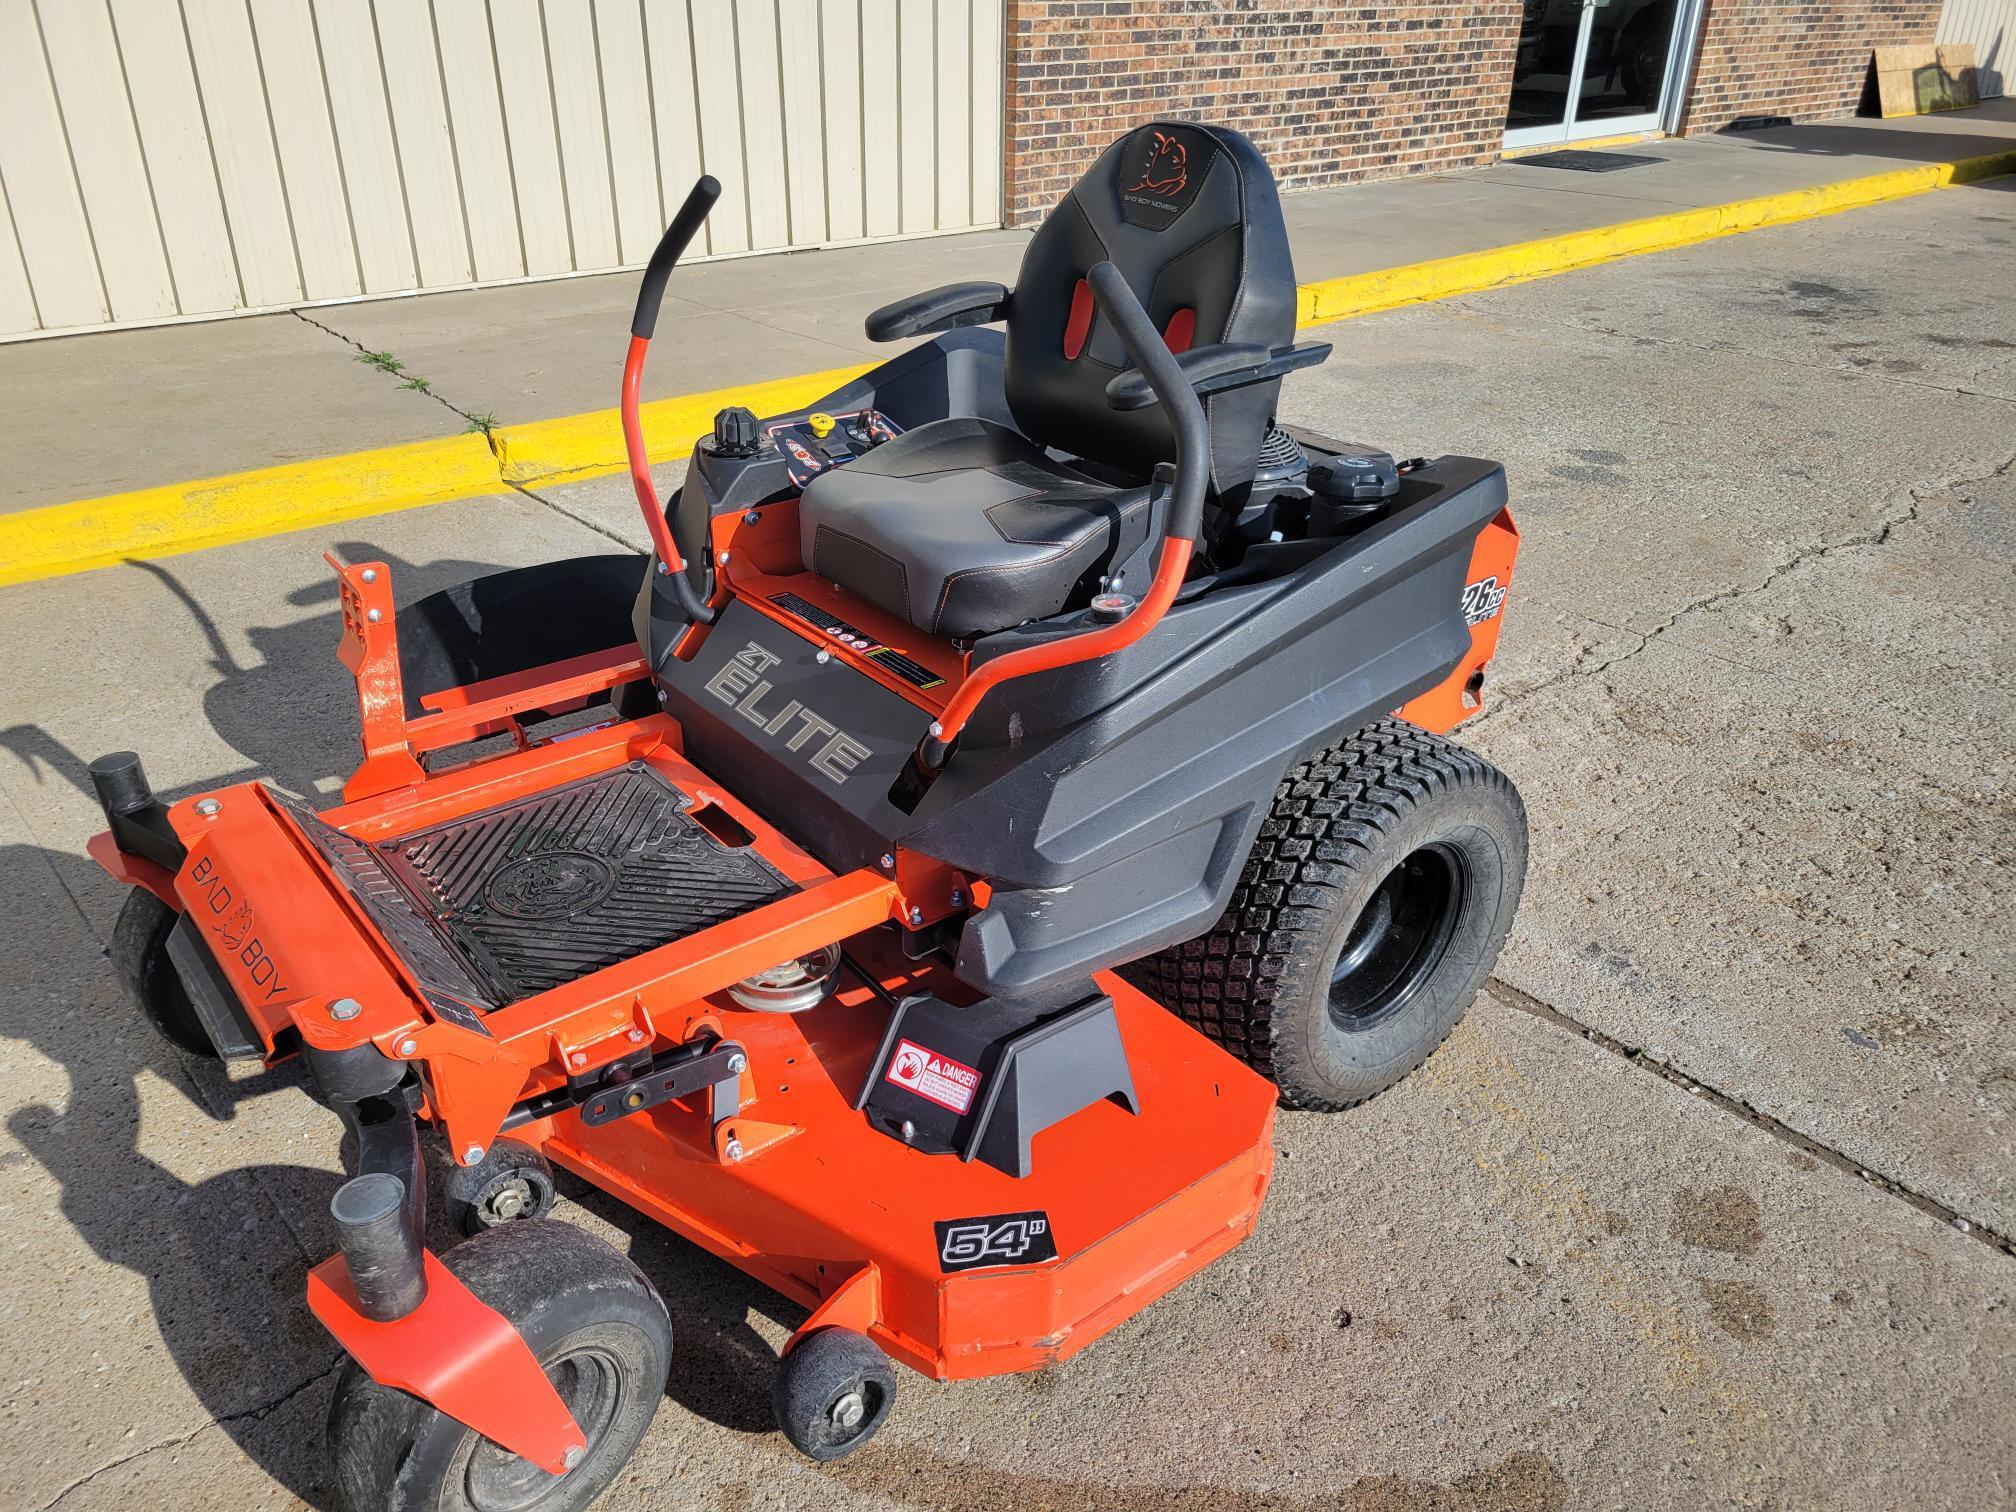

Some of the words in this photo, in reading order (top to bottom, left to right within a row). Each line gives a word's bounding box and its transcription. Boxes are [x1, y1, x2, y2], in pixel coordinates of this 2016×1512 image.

[1124, 194, 1138, 202] BAD
[1137, 196, 1151, 205] BOY
[1151, 201, 1178, 213] MOWERS
[737, 640, 783, 674] ZT
[703, 659, 874, 786] ELITE
[191, 856, 232, 915] BAD
[240, 938, 288, 1000] BOY
[942, 1062, 977, 1089] DANGER
